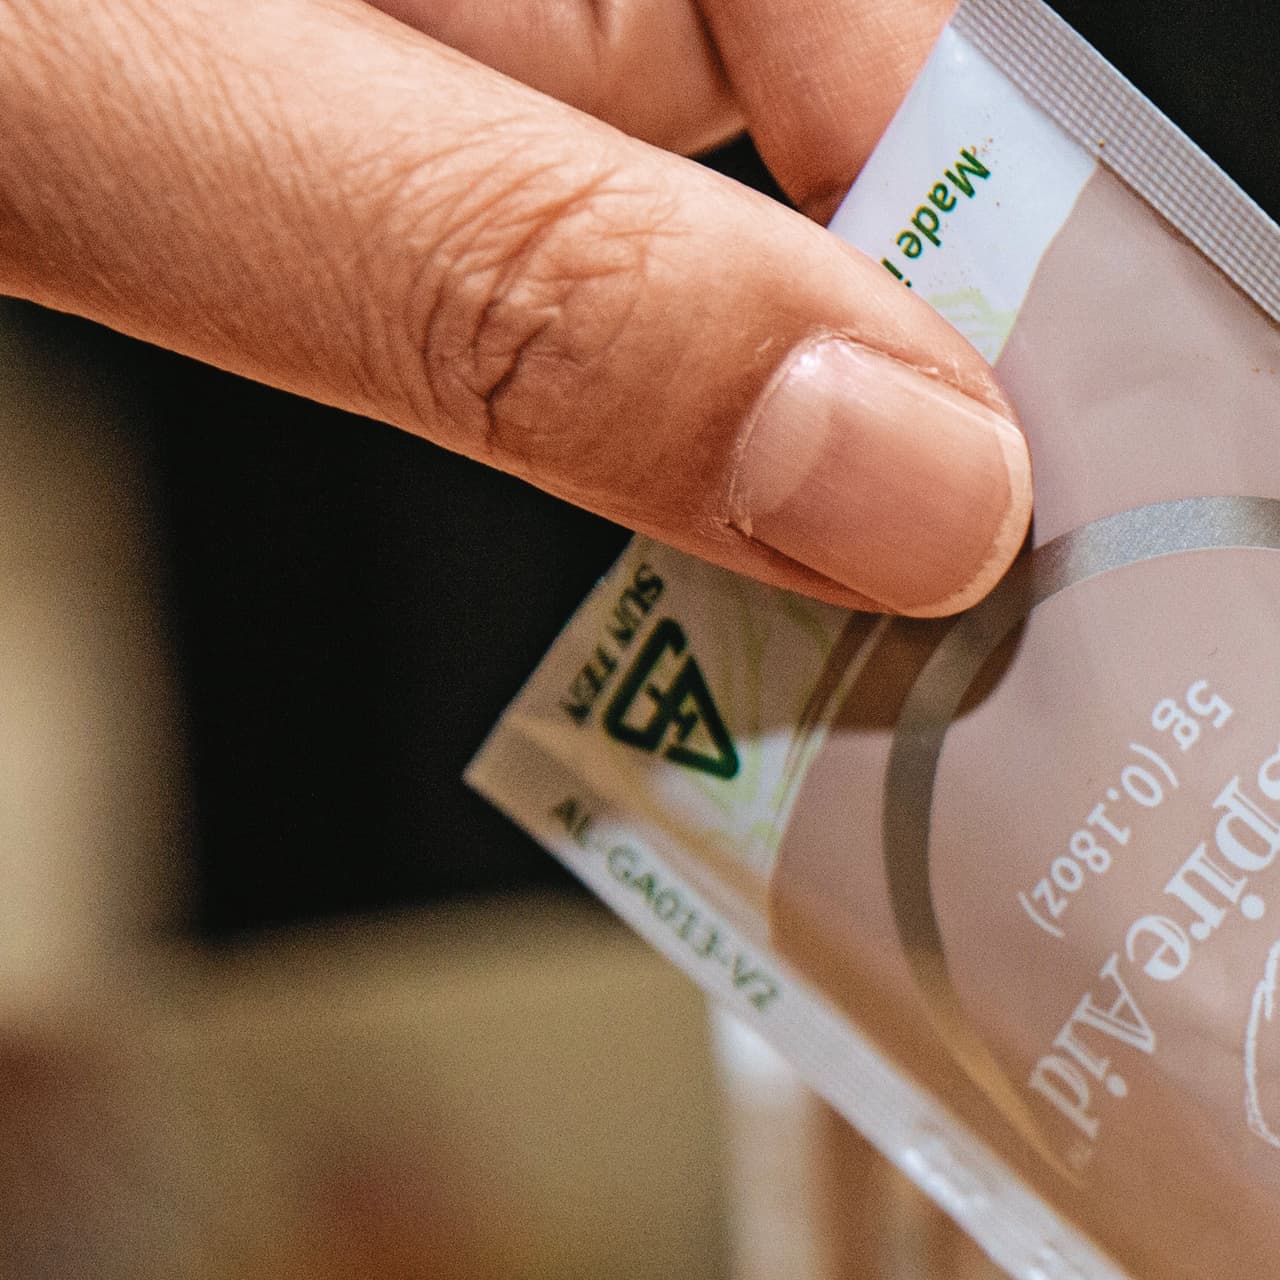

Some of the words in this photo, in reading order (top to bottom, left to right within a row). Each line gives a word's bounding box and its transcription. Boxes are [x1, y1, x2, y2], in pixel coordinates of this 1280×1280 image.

[896, 147, 991, 259] Made
[1150, 679, 1234, 750] 5g
[1019, 741, 1180, 938] (0.18oz)
